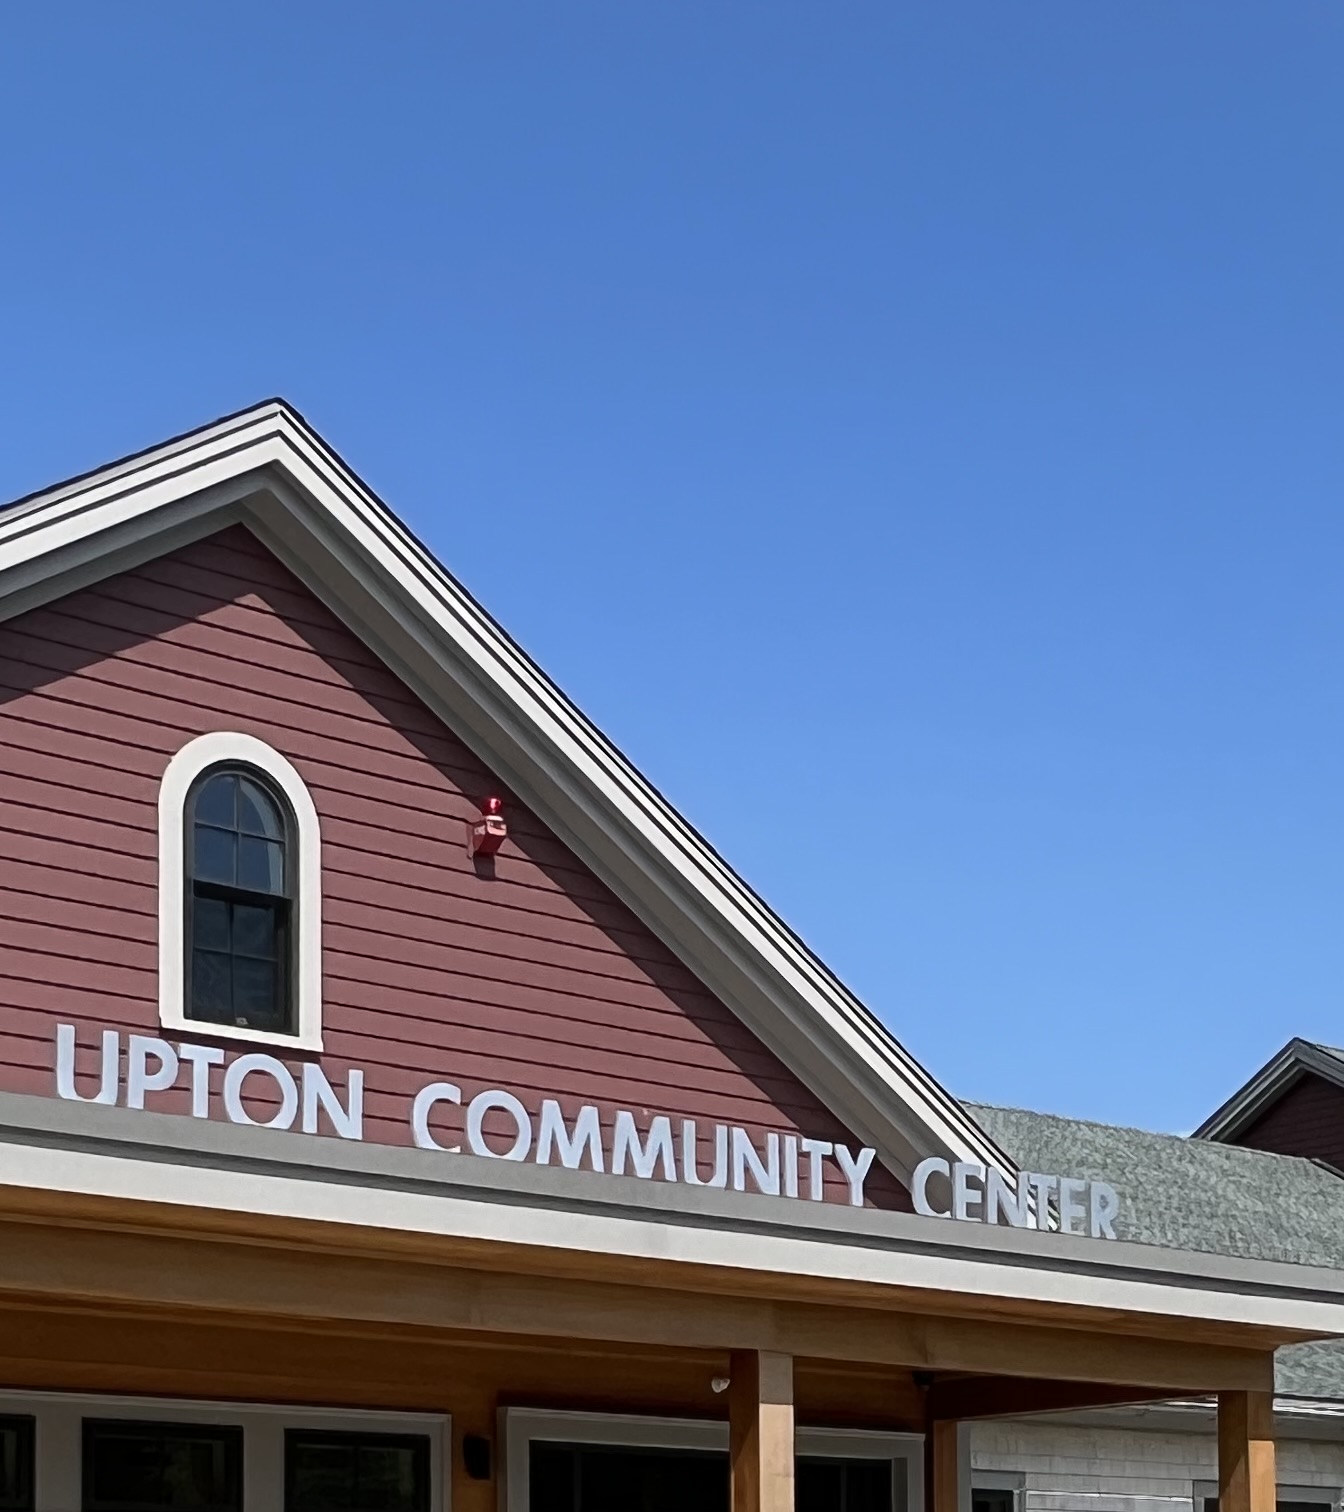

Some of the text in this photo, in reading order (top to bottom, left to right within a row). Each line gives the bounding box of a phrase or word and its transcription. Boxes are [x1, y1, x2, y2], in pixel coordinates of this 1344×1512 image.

[56, 1024, 1120, 1240] UPTON COMMUNITY CENTER
